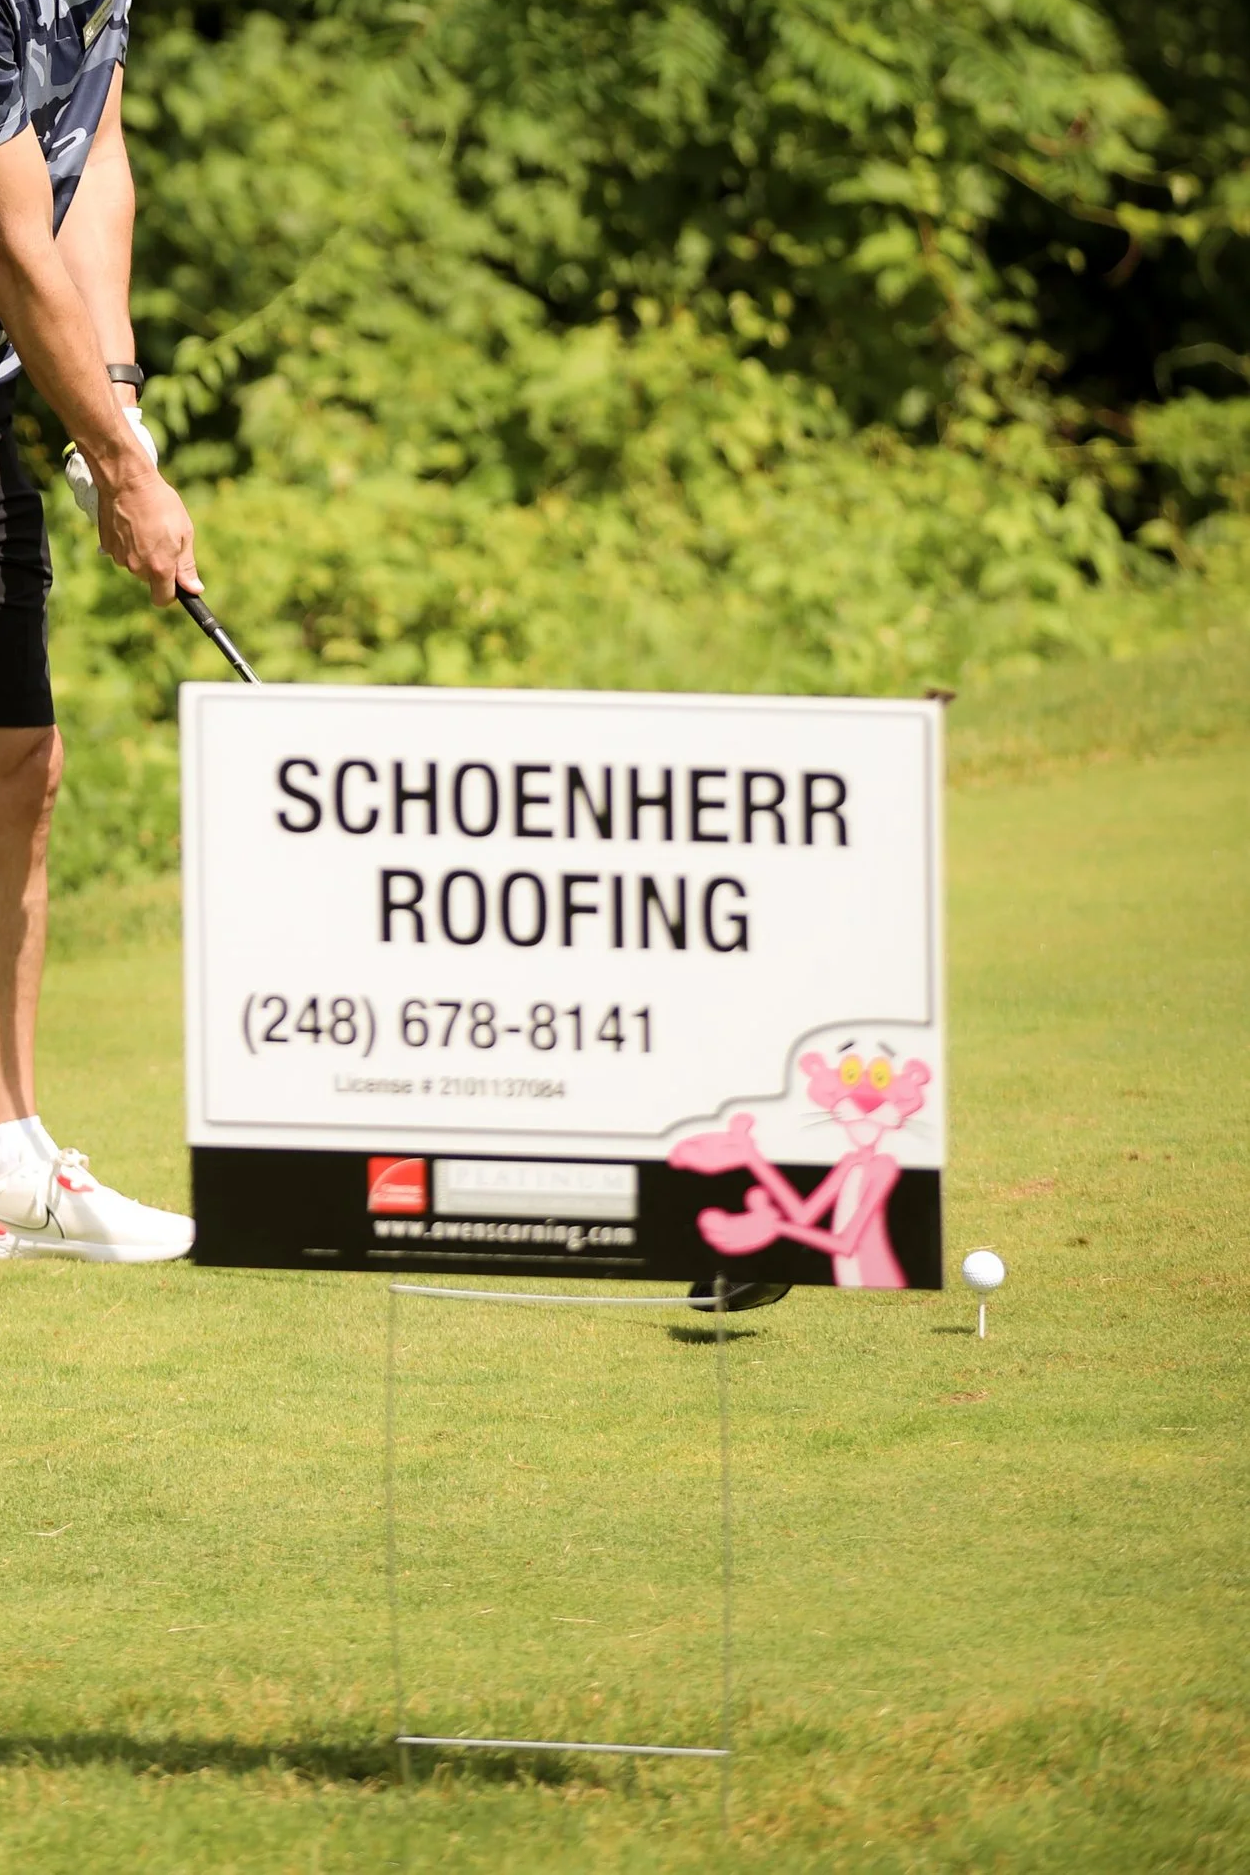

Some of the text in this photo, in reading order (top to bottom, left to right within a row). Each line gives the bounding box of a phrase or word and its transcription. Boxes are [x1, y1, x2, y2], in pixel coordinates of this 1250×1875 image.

[275, 757, 851, 848] SCHOENHERR
[378, 868, 749, 954] ROOFING
[243, 994, 653, 1057] (248) 678-8141
[334, 1074, 414, 1096] License
[372, 1217, 638, 1253] www.owenscorning.com
